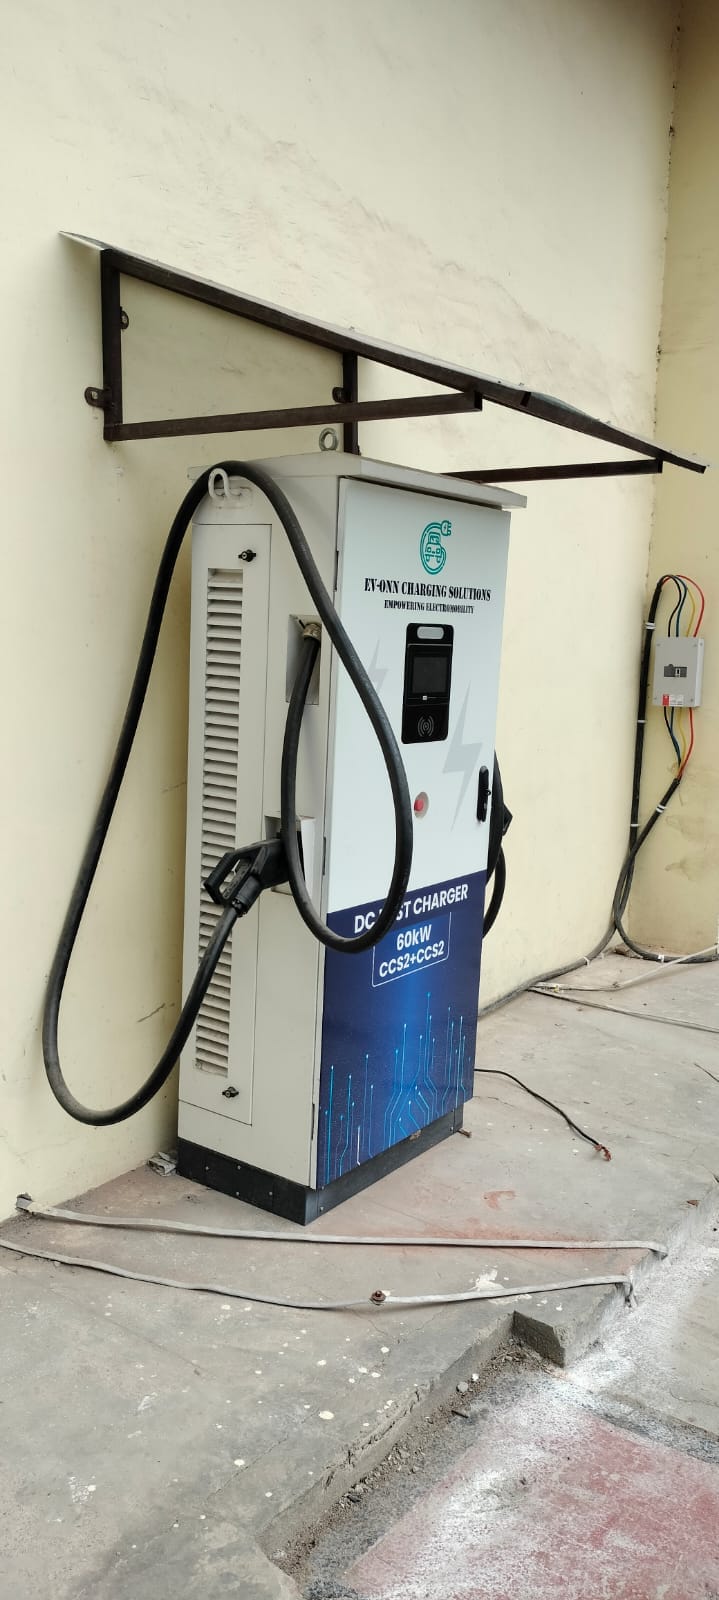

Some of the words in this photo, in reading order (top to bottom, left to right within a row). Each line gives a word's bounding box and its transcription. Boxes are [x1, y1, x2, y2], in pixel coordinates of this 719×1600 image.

[364, 577, 399, 594] EV-ONN
[401, 581, 447, 597] CHARGING
[448, 586, 491, 601] SOLUTIONS
[384, 599, 425, 611] EMPOWERING
[426, 603, 474, 614] ELECTROMOBILITY
[354, 911, 376, 934] DC
[413, 883, 469, 915] CHARGER
[396, 924, 432, 951] 60kW
[379, 940, 445, 977] CCS2+CCS2
